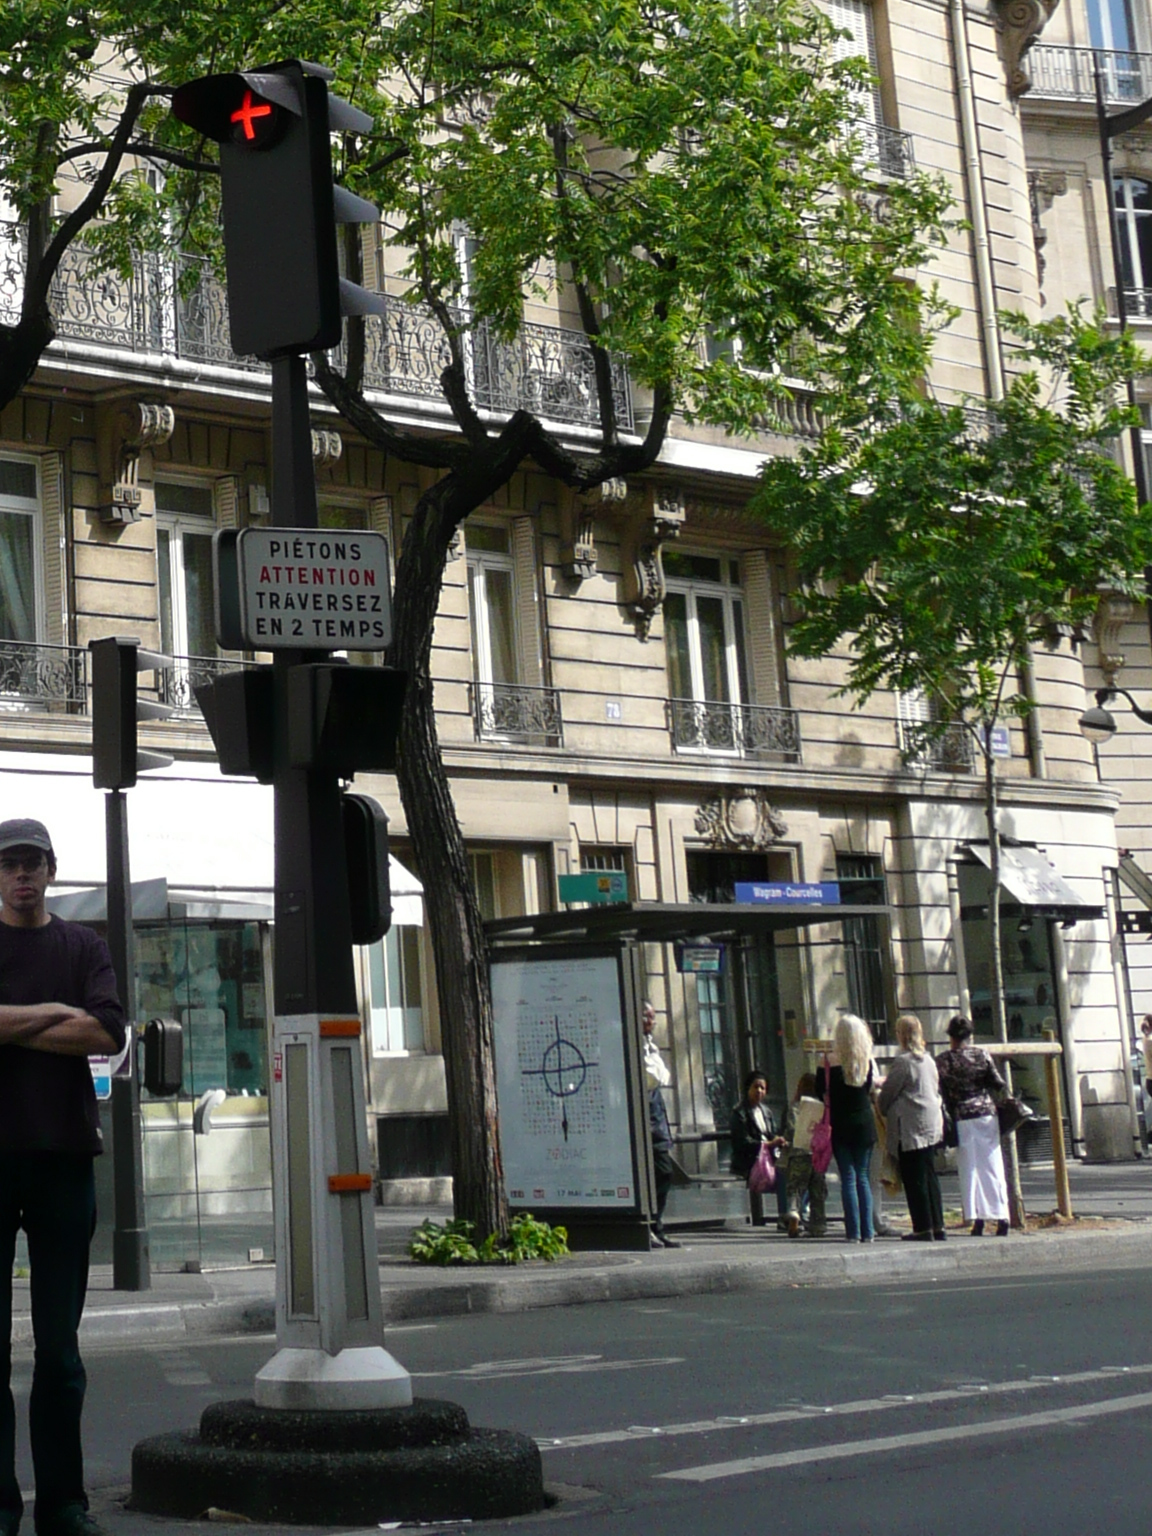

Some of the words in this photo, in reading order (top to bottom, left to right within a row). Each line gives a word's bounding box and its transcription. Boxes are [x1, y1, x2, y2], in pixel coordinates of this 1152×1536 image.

[269, 537, 361, 561] PIÉTONS
[259, 566, 376, 587] ATTENTION
[255, 591, 382, 613] TRAVERSEZ
[256, 617, 282, 636] EN
[291, 619, 303, 636] 2
[312, 619, 384, 638] TEMPS
